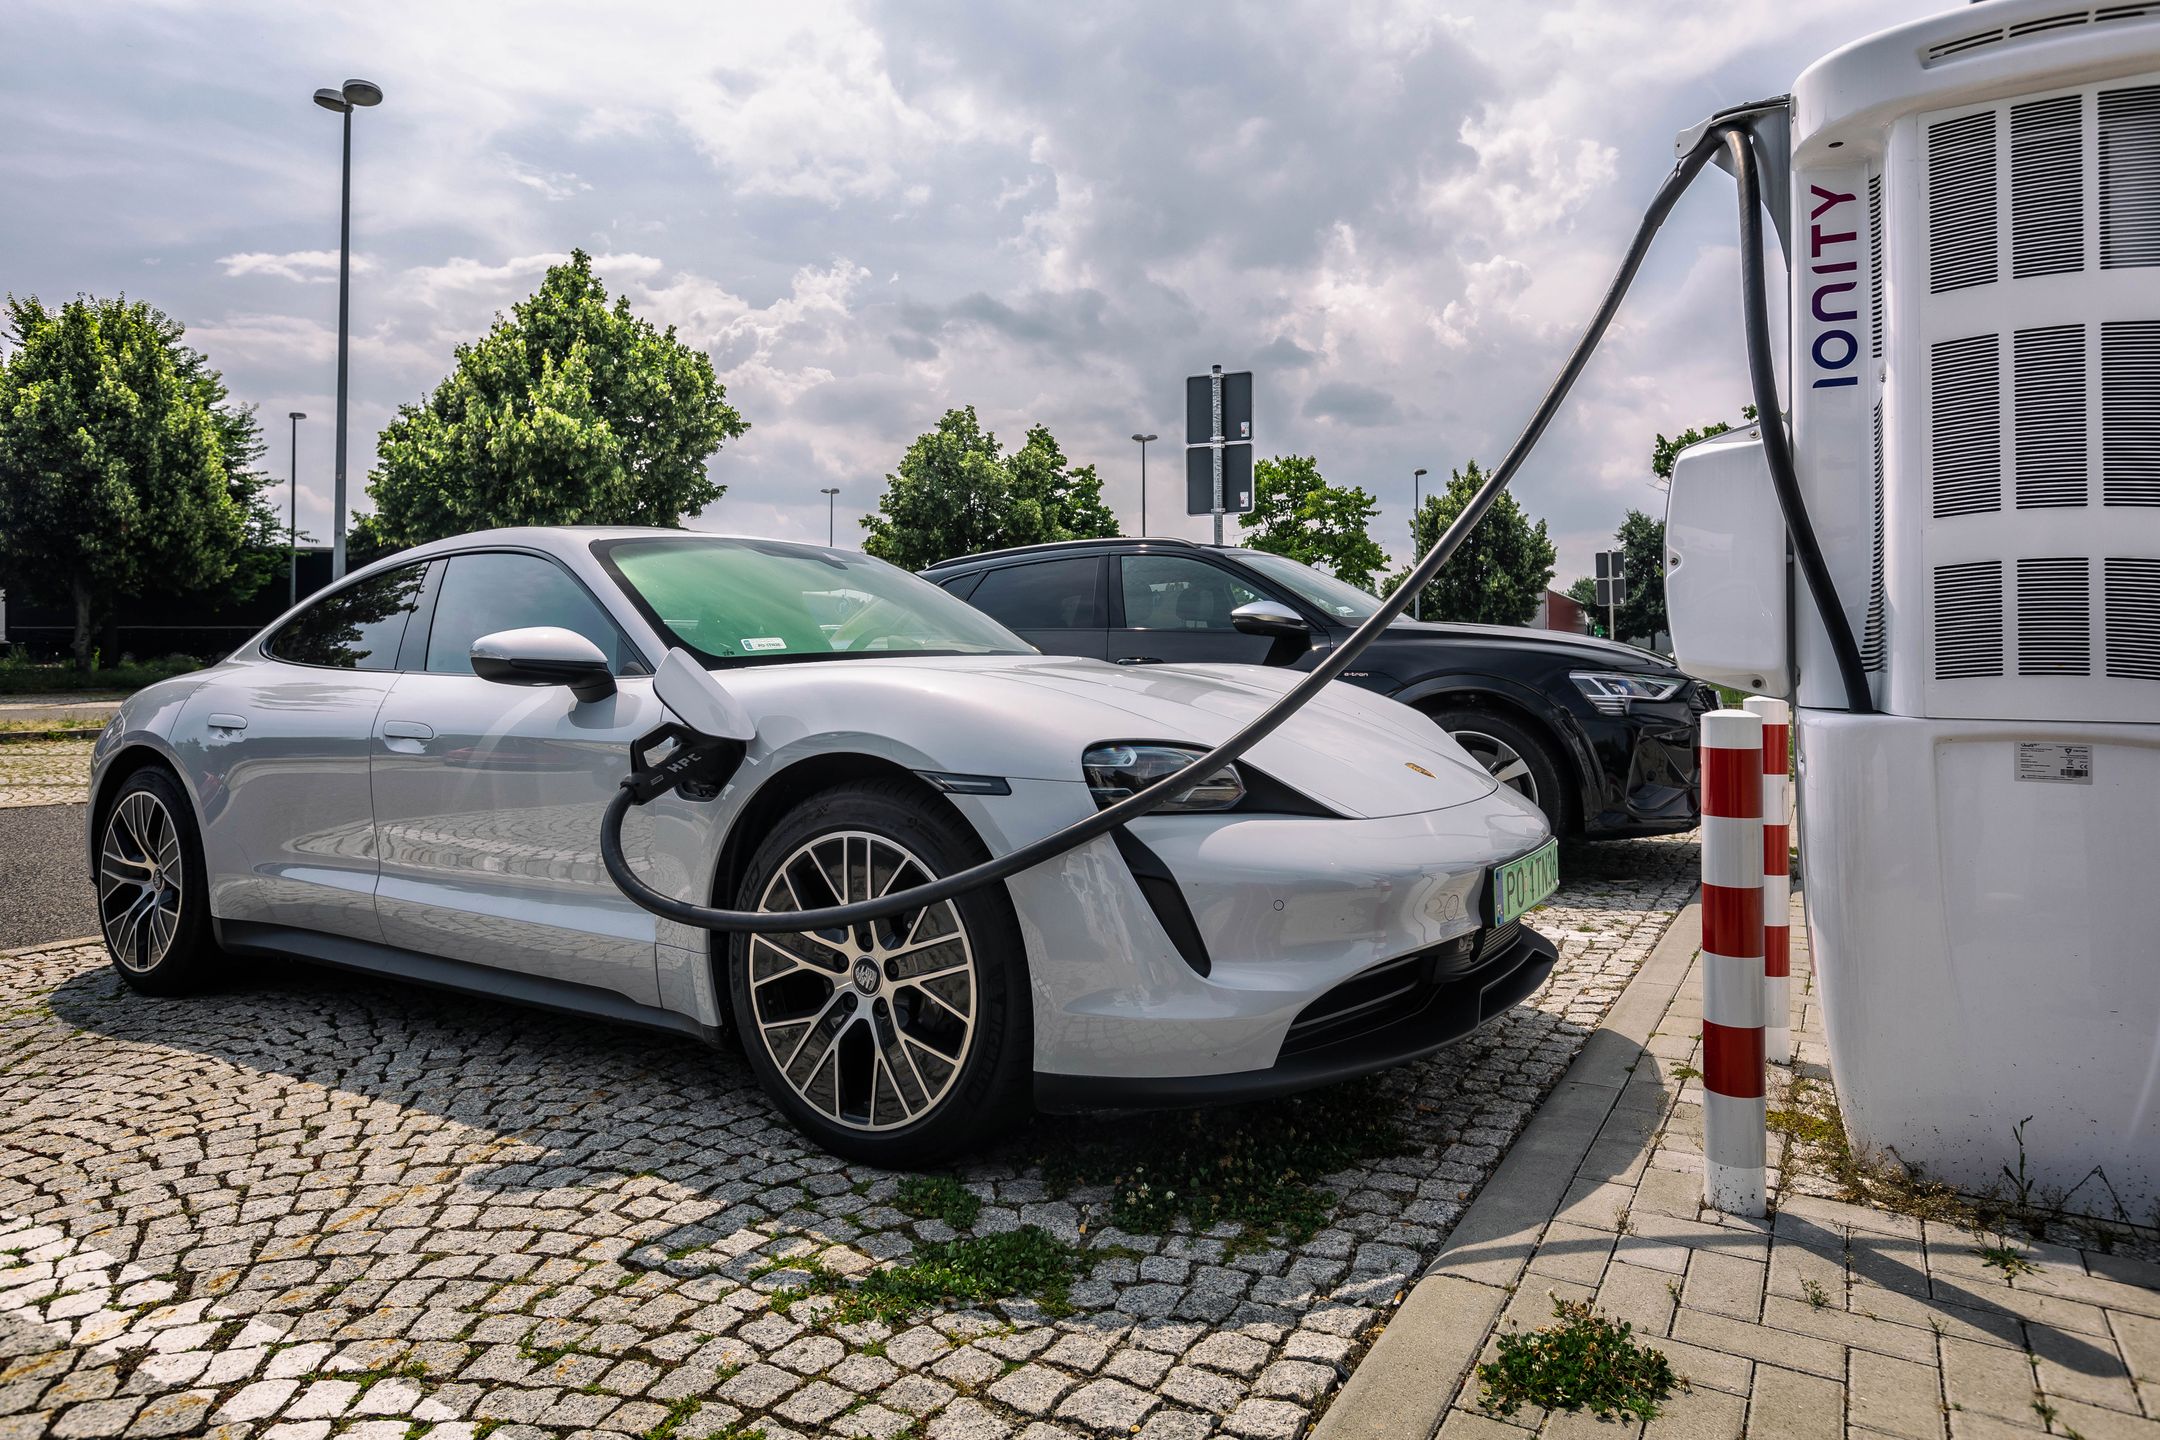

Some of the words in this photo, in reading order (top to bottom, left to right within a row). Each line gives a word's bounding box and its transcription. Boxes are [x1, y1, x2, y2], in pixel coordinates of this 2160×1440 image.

[1811, 184, 1858, 388] IONITY
[667, 753, 702, 773] HPC
[1507, 867, 1524, 915] PO
